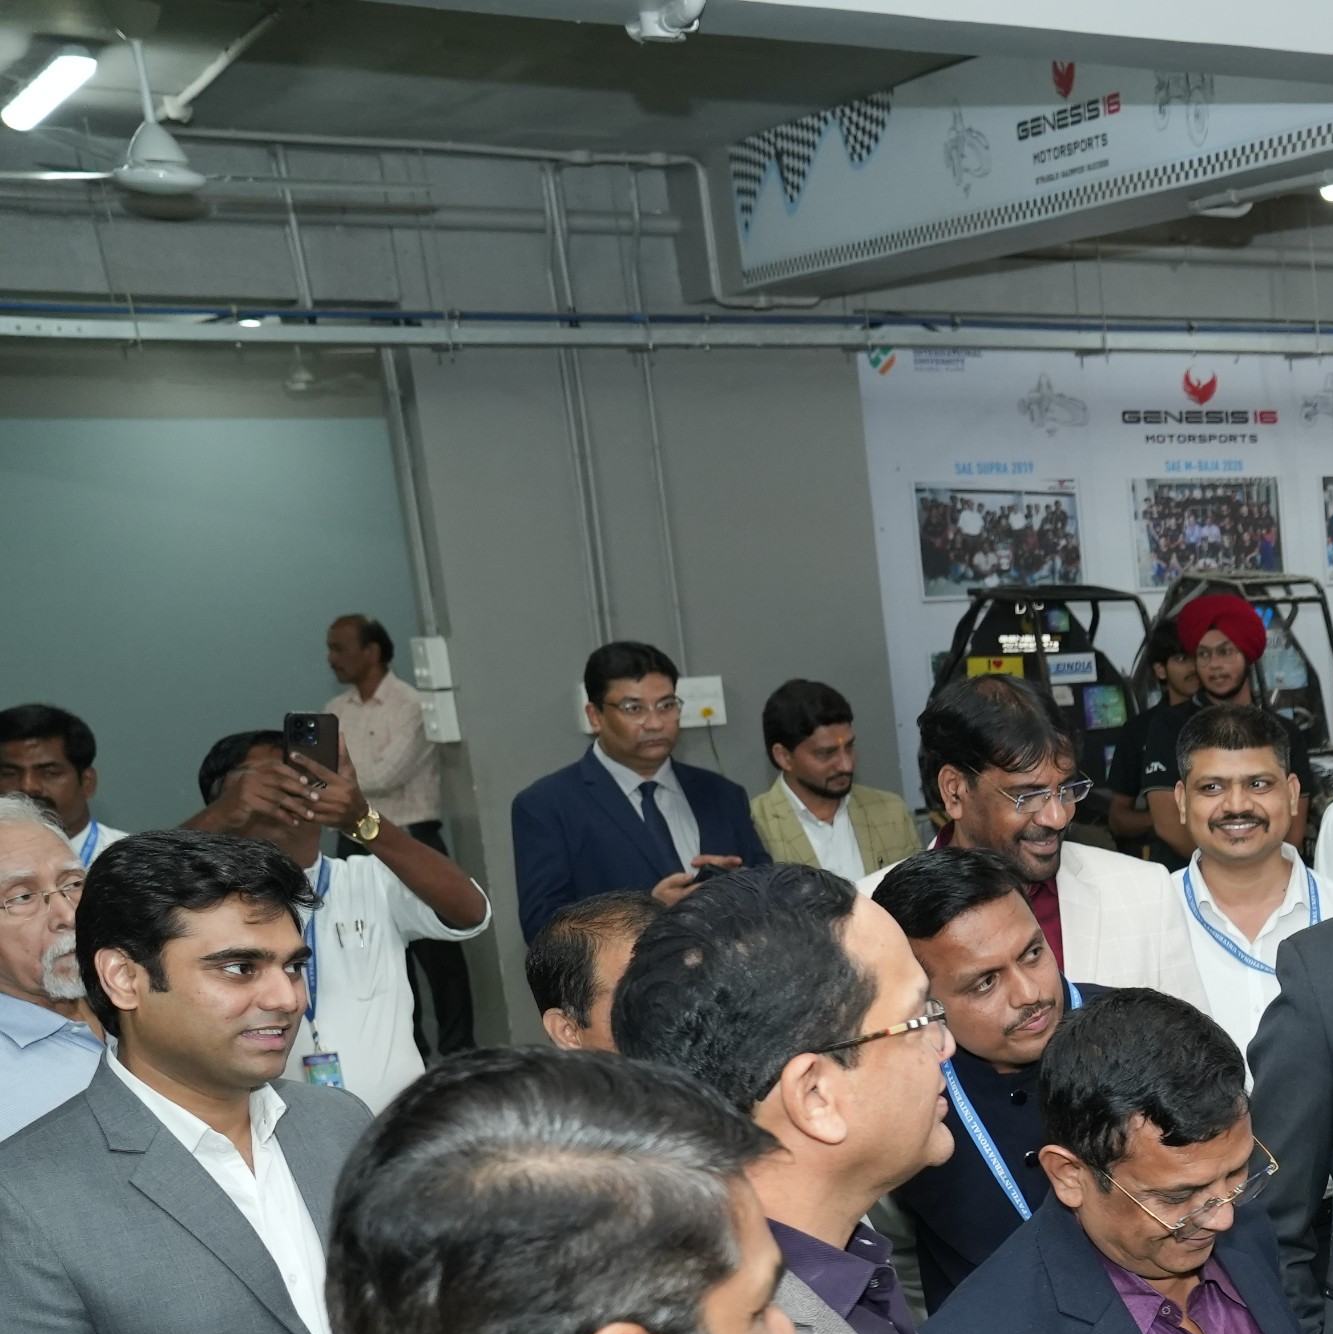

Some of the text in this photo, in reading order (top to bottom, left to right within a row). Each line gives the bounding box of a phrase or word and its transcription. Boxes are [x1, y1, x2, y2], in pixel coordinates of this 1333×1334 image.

[1017, 98, 1100, 141] GENESIS
[1033, 133, 1108, 165] MOTORSPORTS
[1121, 410, 1279, 425] GENESIS 16
[1145, 433, 1258, 444] MOTORSPORTS
[944, 1069, 1028, 1216] PATIL INTERNATIONAL UNIVERSITY
